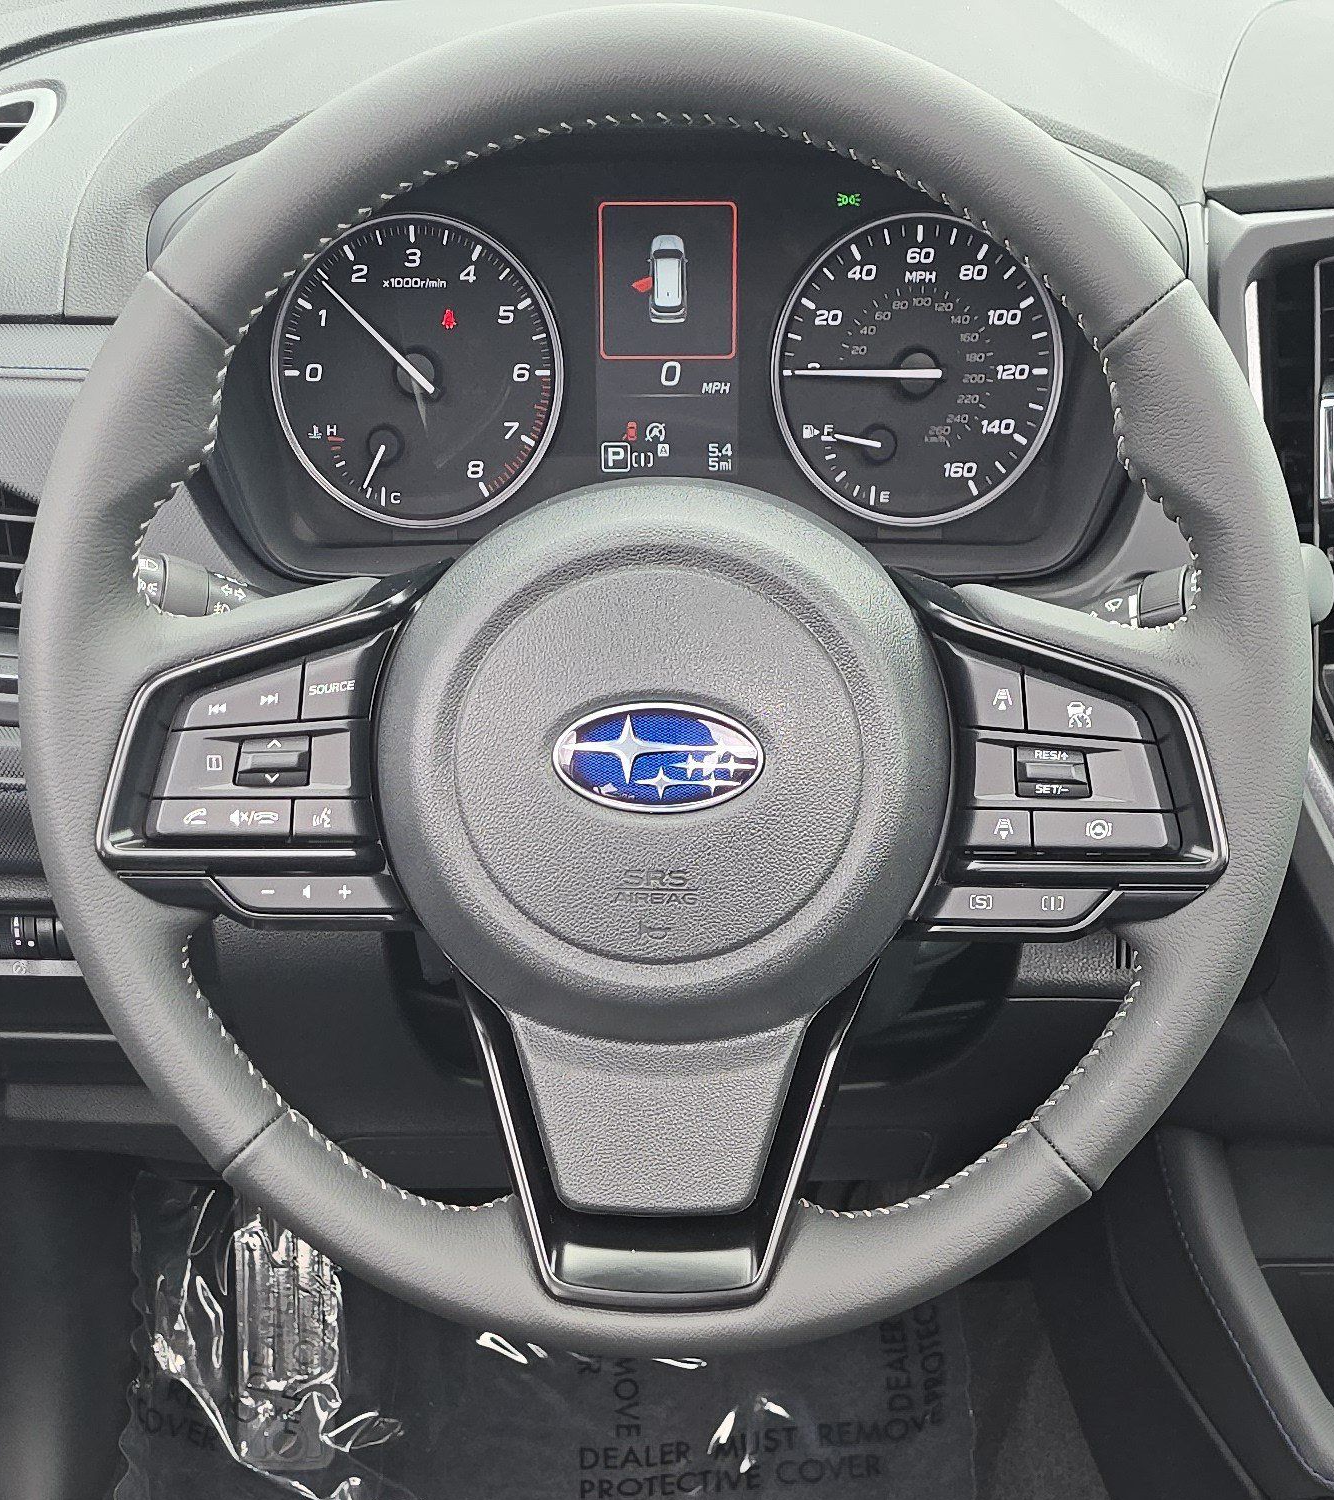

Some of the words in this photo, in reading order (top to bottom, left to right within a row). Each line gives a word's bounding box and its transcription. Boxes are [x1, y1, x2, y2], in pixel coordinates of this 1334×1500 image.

[404, 248, 421, 267] 3
[905, 247, 935, 264] 60
[351, 266, 367, 283] 2
[460, 266, 476, 283] 4
[847, 264, 877, 281] 40
[904, 271, 937, 283] MPH
[958, 264, 988, 281] 80
[382, 278, 447, 289] x1000r/min
[892, 300, 909, 310] 80
[912, 297, 932, 307] 100
[934, 302, 954, 312] 120
[318, 310, 327, 327] 1
[497, 305, 515, 324] 5
[815, 309, 843, 326] 20
[874, 311, 892, 321] 60
[950, 315, 970, 325] 140
[987, 309, 1022, 326] 100
[859, 325, 877, 335] 40
[851, 345, 867, 355] 20
[965, 353, 985, 363] 180
[305, 363, 323, 382] 0
[512, 364, 530, 382] 6
[660, 361, 681, 386] 0
[962, 373, 986, 383] 200
[996, 364, 1030, 380] 120
[701, 382, 730, 394] MPH
[956, 394, 979, 404] 220
[946, 413, 969, 424] 240
[980, 418, 1015, 435] 140
[327, 425, 337, 436] H
[504, 421, 520, 440] 7
[823, 424, 834, 435] F
[928, 425, 951, 436] 260
[607, 447, 625, 466] P
[467, 461, 484, 479] 8
[943, 462, 978, 479] 160
[390, 492, 402, 504] C
[879, 491, 890, 503] E
[308, 680, 356, 695] SOURCE
[622, 869, 689, 886] SRS
[579, 1441, 691, 1471] DEALER
[579, 1465, 762, 1499] PROTECTIVE
[776, 1455, 883, 1485] COVER
